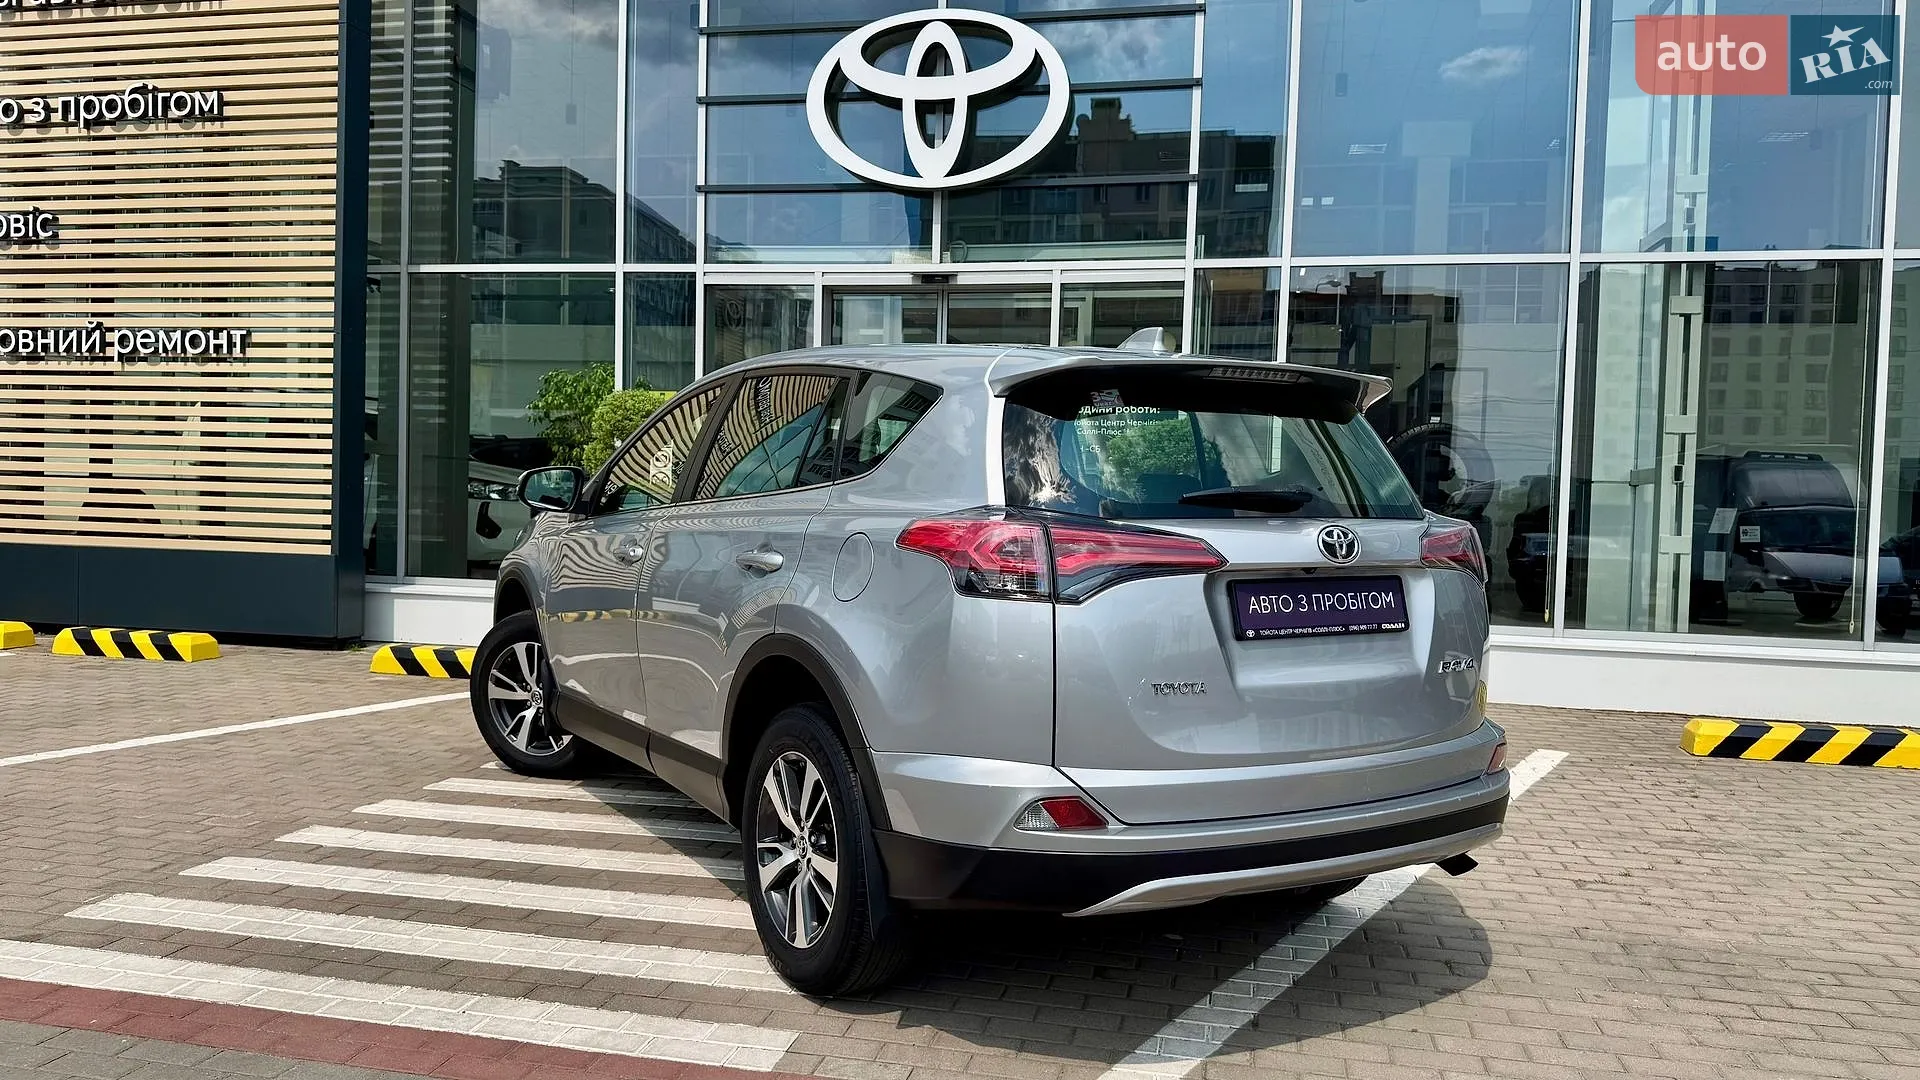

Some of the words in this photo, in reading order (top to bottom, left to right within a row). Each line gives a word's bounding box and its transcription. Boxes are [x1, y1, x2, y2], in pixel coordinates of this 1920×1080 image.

[31, 97, 45, 122] з
[58, 82, 218, 129] пробігом
[114, 329, 247, 362] ремонт
[1249, 594, 1293, 614] АВТО
[1312, 591, 1395, 611] ПРОБІГОМ
[1150, 681, 1208, 696] TOYOTA
